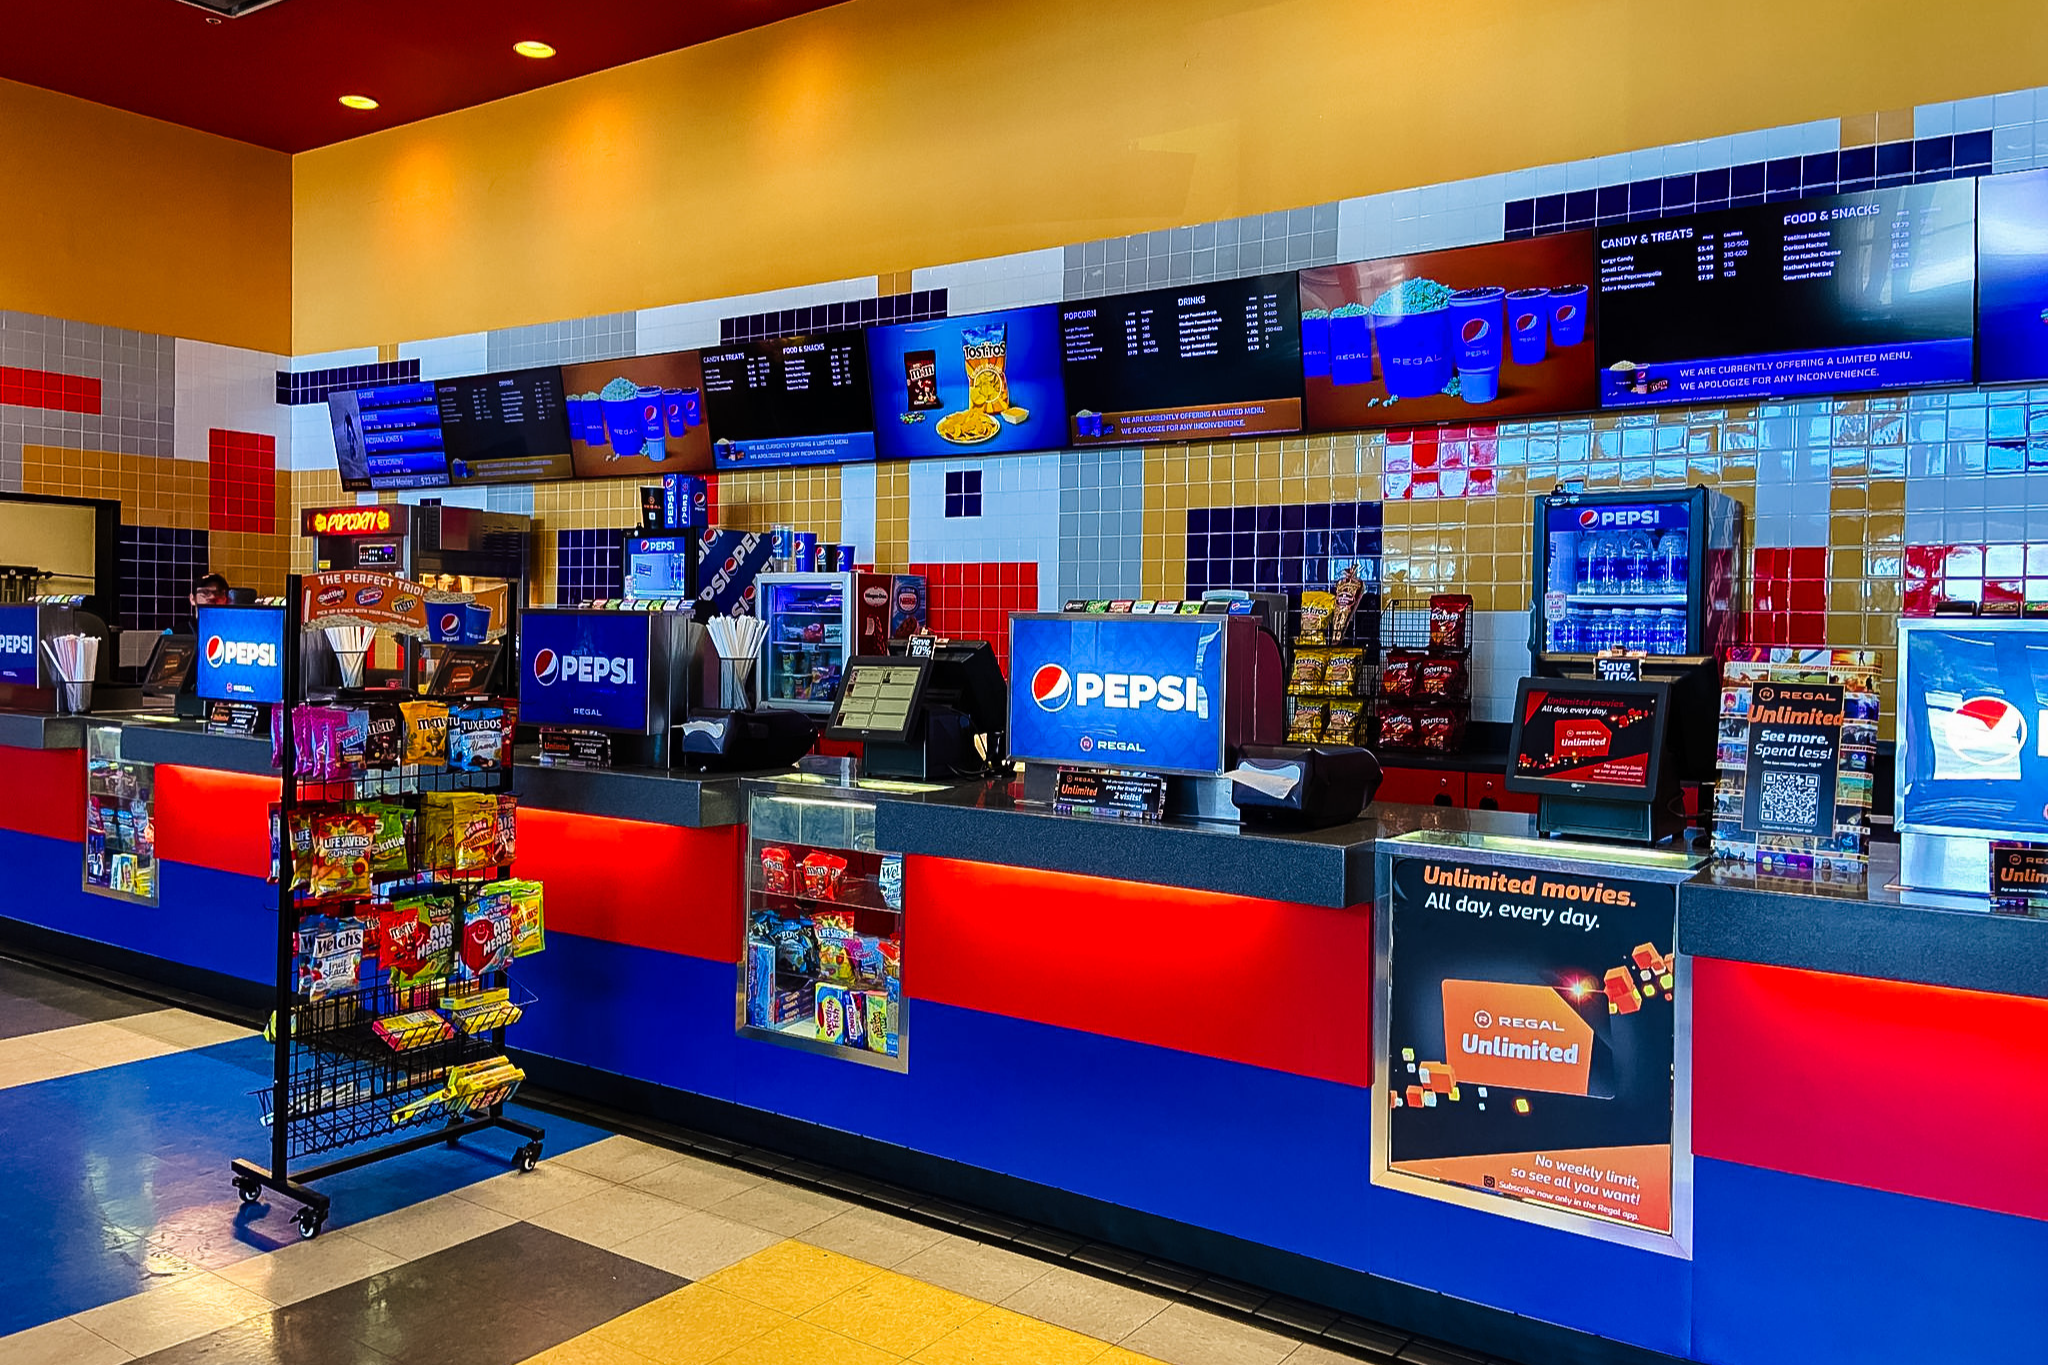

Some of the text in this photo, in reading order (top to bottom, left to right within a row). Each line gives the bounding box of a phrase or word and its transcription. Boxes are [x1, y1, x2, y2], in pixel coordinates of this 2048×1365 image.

[1783, 204, 1880, 226] FOOD & SNACKS
[1601, 228, 1694, 249] CANDY & TREATS
[1617, 255, 1634, 263] Candy
[1810, 261, 1821, 269] Hot
[1822, 260, 1835, 268] Dog
[1617, 264, 1635, 272] Candy
[1178, 295, 1206, 307] DRINKS
[1064, 309, 1097, 320] POPCORN
[782, 346, 798, 355] FOOD
[803, 343, 825, 352] SNACKS
[963, 340, 1007, 360] TOSTITOS
[1335, 353, 1369, 361] REGAL
[1465, 350, 1490, 358] PEPSI
[703, 354, 720, 363] CANDY
[725, 352, 745, 361] TREATS
[1392, 354, 1442, 366] REGAL
[1680, 351, 1913, 377] WE ARE CURRENTLY OFFERING A LIMITED MENU.
[1680, 368, 1880, 391] WE APOLOGIZE FOR ANY INCONVENIENCE.
[1131, 415, 1144, 424] ARE
[1144, 413, 1180, 423] CURRENTLY
[1180, 410, 1211, 420] OFFERING
[1217, 407, 1244, 417] LIMITED
[1121, 427, 1132, 435] WE
[1132, 424, 1166, 434] APOLOGIZE
[1166, 423, 1179, 432] FOR
[1179, 422, 1193, 431] ANY
[667, 491, 675, 525] PEPSI
[681, 494, 689, 525] REGAL
[327, 511, 377, 533] POPCORN
[1601, 510, 1660, 526] PEPSI
[650, 541, 675, 552] PEPSI
[317, 573, 425, 597] THE PERFECT TRIO!
[911, 637, 931, 646] Save
[224, 641, 277, 667] PEPSI
[912, 645, 932, 656] 10%
[561, 655, 636, 685] PEPSI
[1598, 660, 1631, 672] Save
[1603, 671, 1637, 681] 10%
[1076, 671, 1198, 712] PEPSI
[1779, 691, 1837, 702] REGAL
[1541, 705, 1608, 716] All every day.
[1547, 697, 1627, 708] Unlimited movies.
[573, 707, 603, 717] REGAL
[1747, 703, 1845, 727] Unlimited
[462, 718, 502, 731] TUXEDOS
[1561, 737, 1607, 747] Unlimited
[1760, 729, 1829, 746] See more.
[1097, 740, 1146, 753] REGAL
[1754, 743, 1833, 761] Spend less!
[1061, 783, 1098, 797] Unlimited
[1113, 791, 1142, 802] 2 visits!
[294, 829, 311, 842] LIFE
[324, 835, 370, 848] LIFE SAVERS
[1423, 864, 1637, 908] Unlimited movies.
[429, 907, 452, 918] bites
[1424, 891, 1601, 932] All day, every day.
[429, 922, 453, 941] AIR
[494, 917, 511, 937] AIR
[317, 931, 362, 955] Welch's
[416, 934, 453, 961] HEADS
[483, 930, 512, 957] HEADS
[1498, 1016, 1565, 1032] REGAL
[1462, 1033, 1579, 1065] Unlimited
[1534, 1153, 1641, 1190] No weekly limit,
[1510, 1167, 1641, 1206] so see all you want!
[1498, 1180, 1640, 1221] Subscribe now only in the Regal app.
